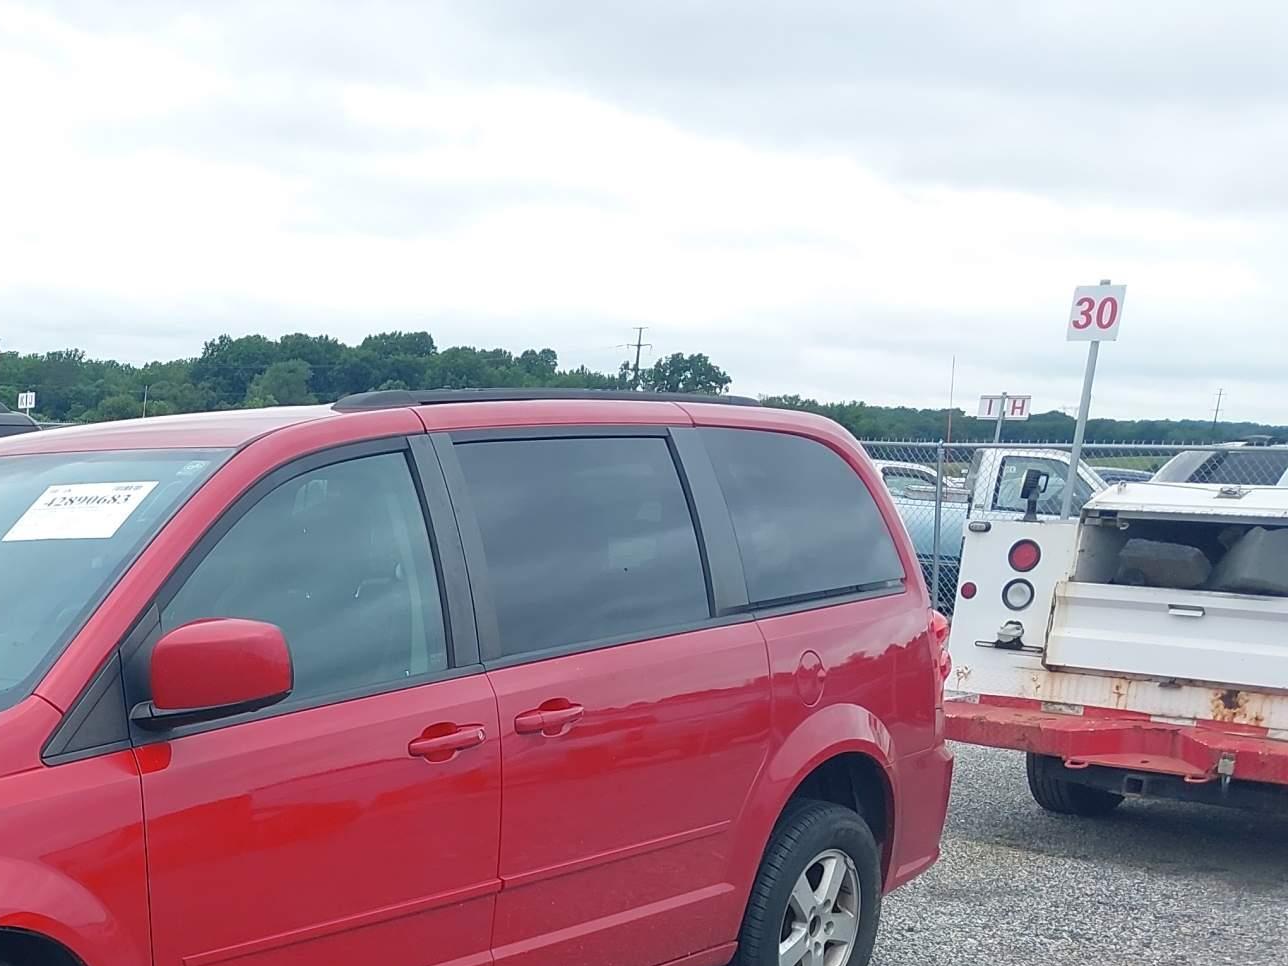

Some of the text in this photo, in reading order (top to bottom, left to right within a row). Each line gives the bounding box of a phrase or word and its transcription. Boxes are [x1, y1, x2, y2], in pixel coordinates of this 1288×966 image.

[1072, 296, 1118, 330] 30
[1011, 399, 1026, 416] H
[43, 494, 132, 507] 42890683
